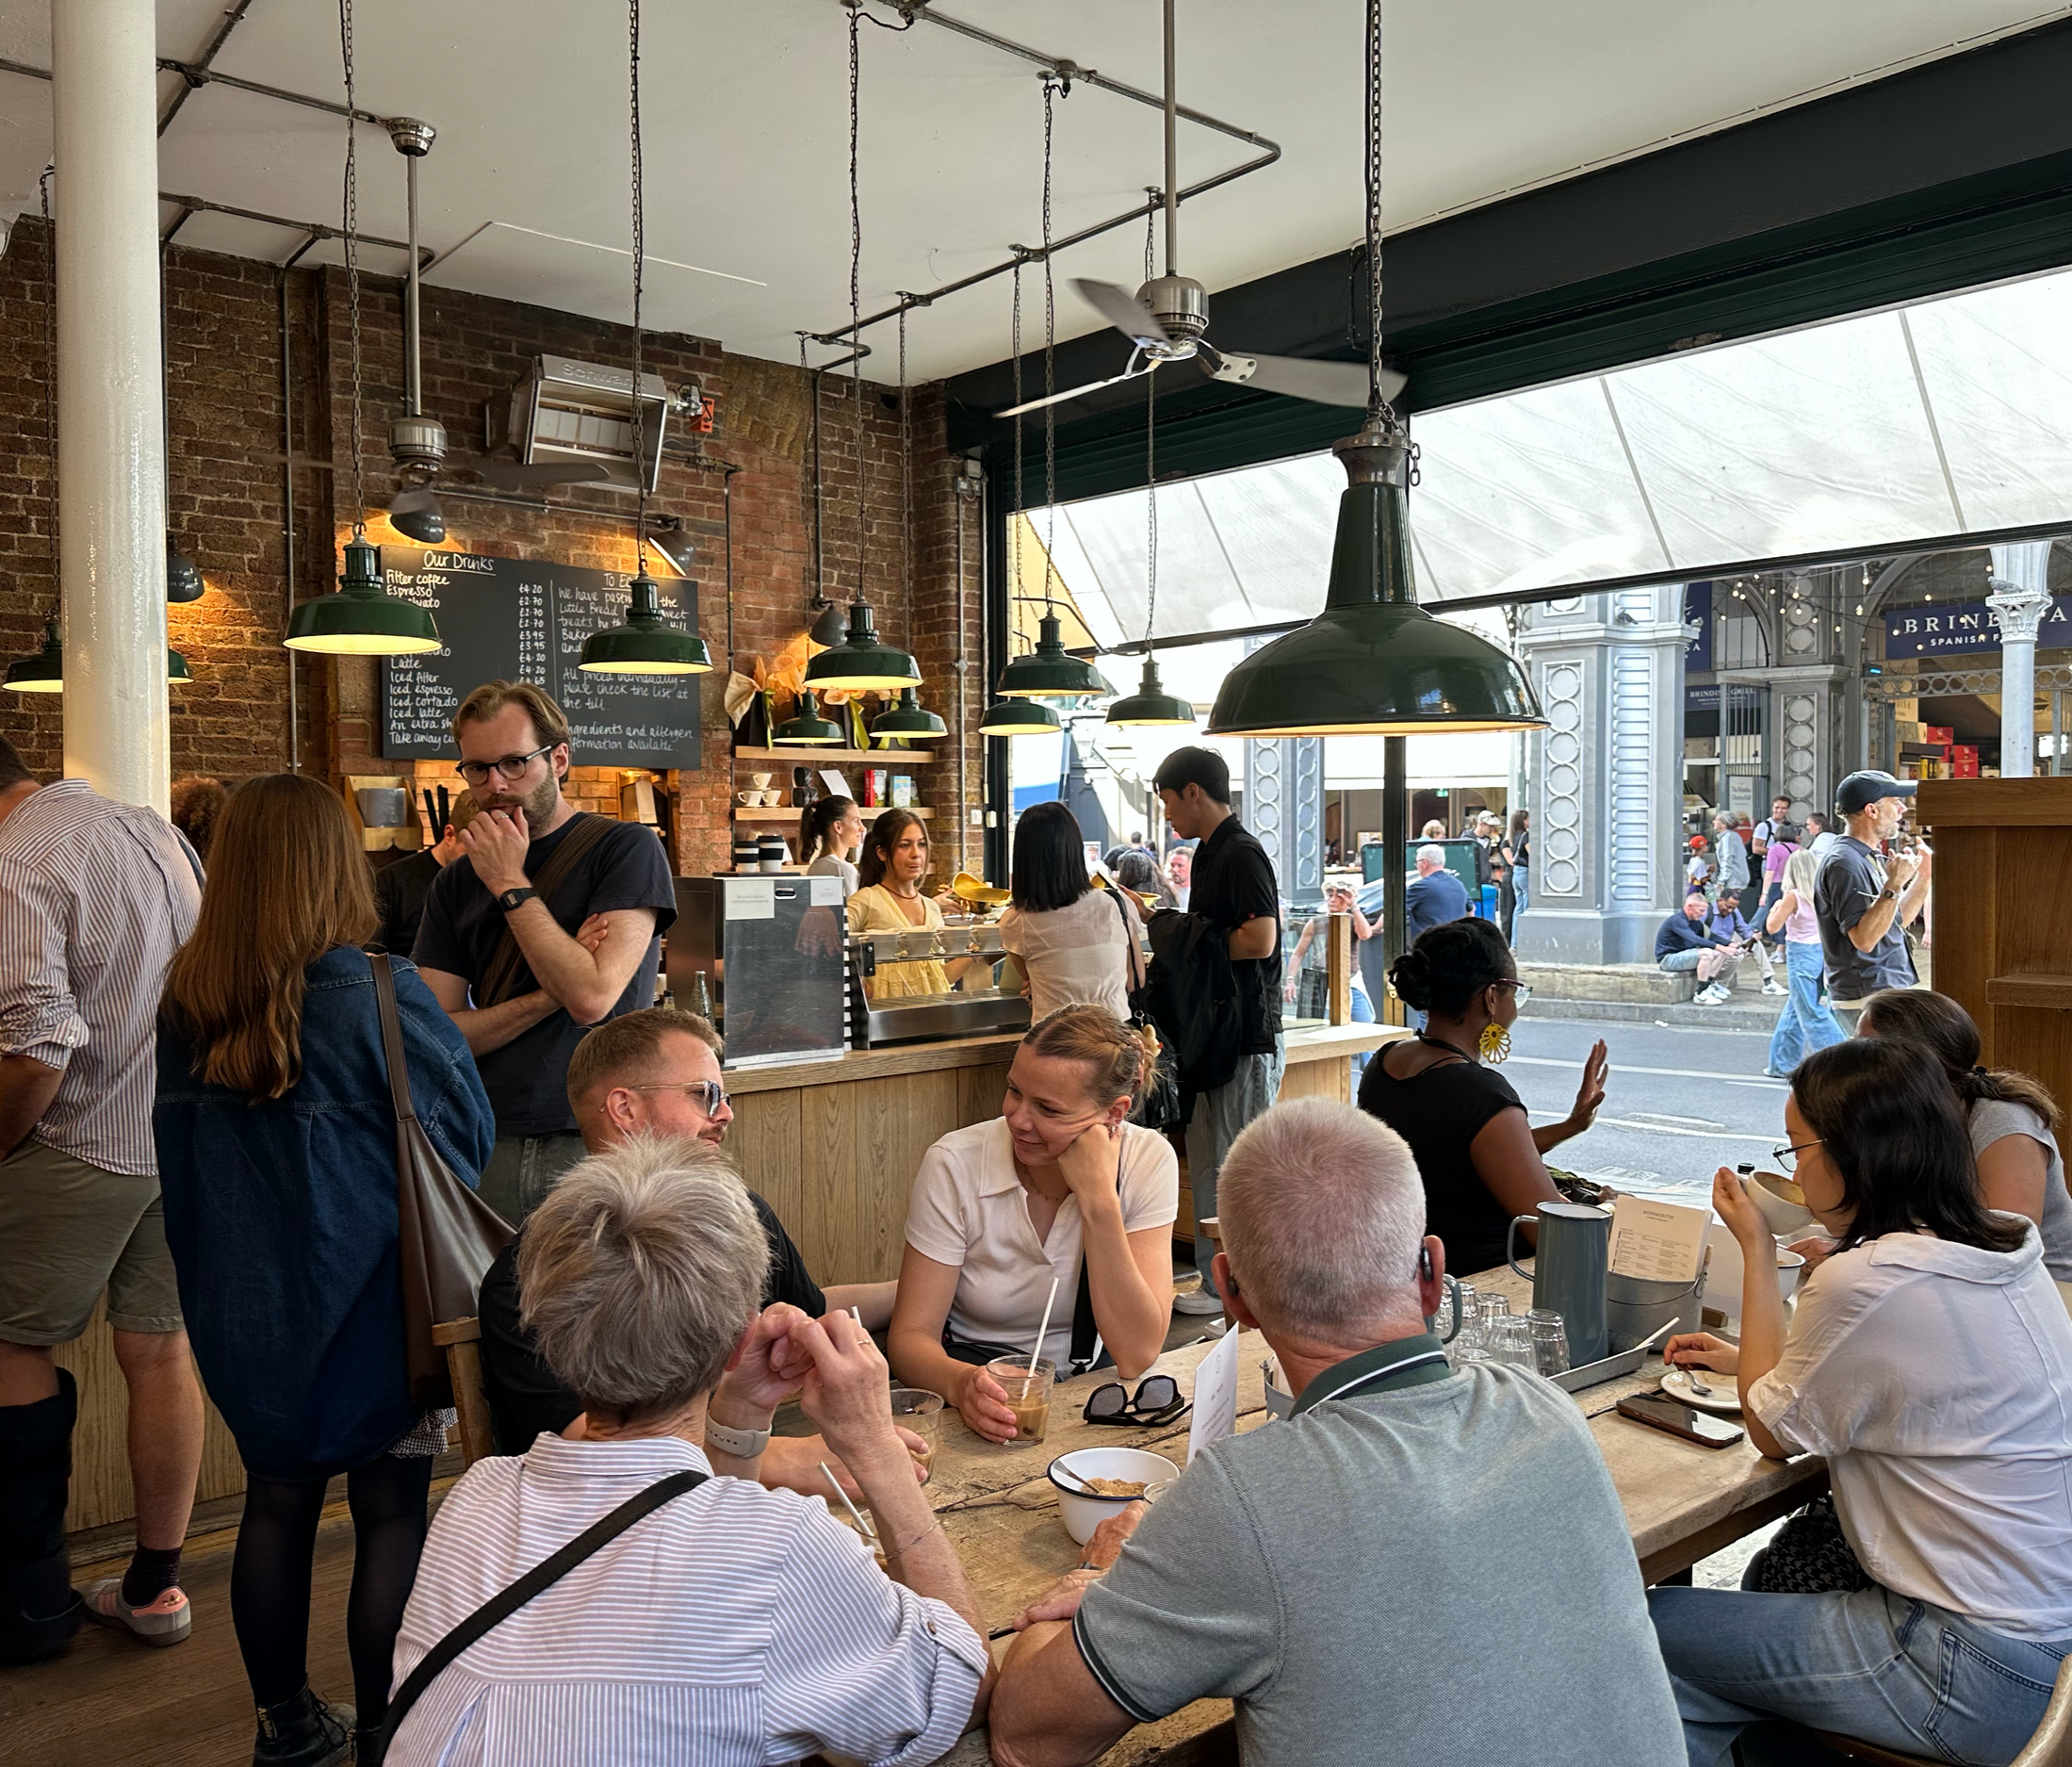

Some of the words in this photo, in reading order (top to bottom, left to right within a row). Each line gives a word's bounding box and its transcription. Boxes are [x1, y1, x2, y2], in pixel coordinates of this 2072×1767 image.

[424, 549, 449, 567] Our
[453, 553, 495, 571] Drinks
[386, 569, 414, 584] Filter
[416, 574, 450, 589] coffee
[619, 574, 639, 587] Ea
[386, 584, 432, 598] Espresso
[559, 587, 573, 599] We
[576, 587, 598, 602] have
[605, 592, 633, 608] pastri
[660, 596, 678, 608] the
[560, 603, 586, 614] Little
[590, 603, 618, 616] Bread
[662, 609, 690, 619] weet
[557, 616, 593, 628] treats
[612, 618, 622, 627] th
[1903, 607, 2067, 633] BRINDA
[562, 628, 594, 641] Baker
[562, 642, 582, 653] and
[391, 658, 422, 669] Latte
[390, 671, 414, 683] Iced
[416, 671, 440, 684] filter
[563, 667, 578, 679] All
[390, 683, 412, 695] Iced
[415, 684, 453, 697] espresso
[597, 684, 628, 695] check
[630, 685, 649, 695] the
[653, 687, 671, 698] list
[677, 687, 689, 699] at
[1689, 689, 1728, 698] BRINDIS
[390, 695, 414, 707] Iced
[416, 695, 458, 708] cortado
[562, 696, 582, 709] the
[390, 707, 415, 719] Iced
[419, 708, 445, 718] latte
[390, 720, 406, 730] An
[411, 719, 439, 729] extra
[441, 718, 453, 729] sh
[567, 721, 622, 739] ngredients
[626, 724, 646, 736] and
[650, 725, 693, 743] allergen
[389, 731, 412, 744] Take
[414, 733, 441, 751] away
[443, 734, 455, 744] cu
[571, 738, 622, 751] formation
